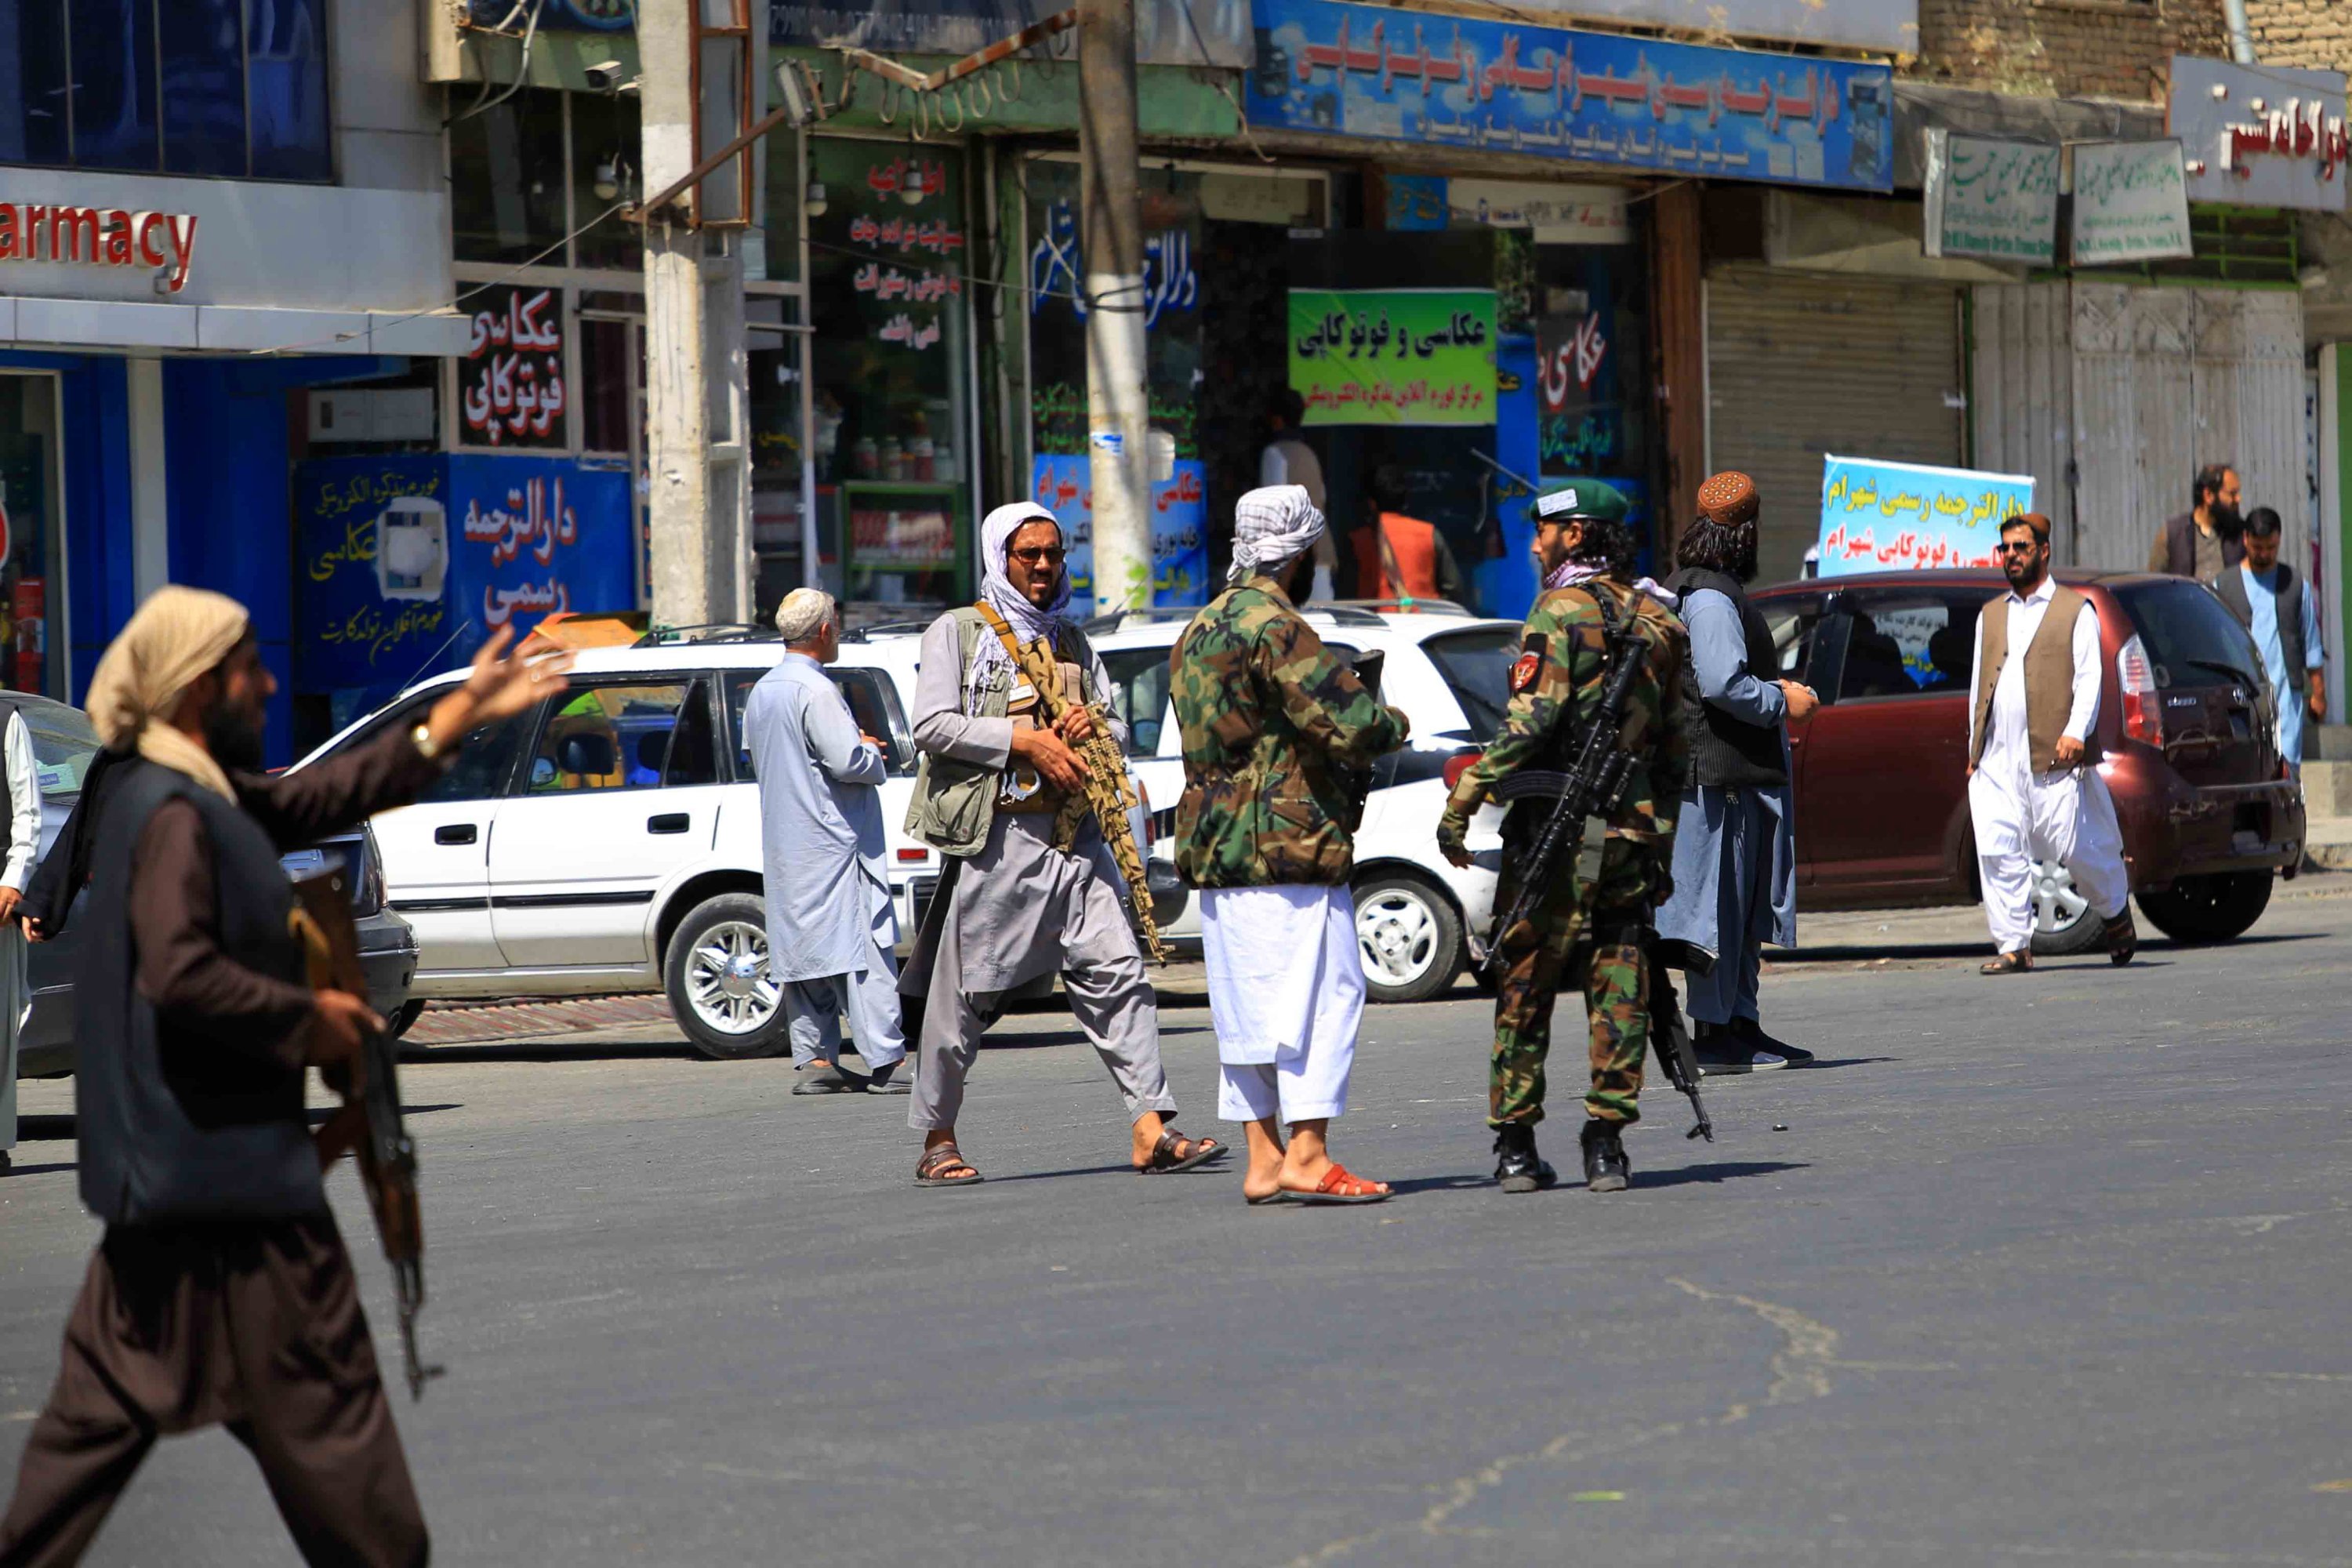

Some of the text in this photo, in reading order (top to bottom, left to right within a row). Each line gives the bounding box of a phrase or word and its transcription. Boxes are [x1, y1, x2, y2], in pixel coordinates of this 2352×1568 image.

[1479, 30, 1554, 102] عکاسی
[869, 158, 946, 201] اطاعیه
[0, 202, 198, 293] armacy
[1144, 230, 1198, 329] دارالتر
[469, 290, 562, 359] عکاسی
[1396, 326, 1408, 359] و
[1414, 311, 1486, 358] عکاسی
[1545, 311, 1607, 415] عکاسی
[465, 353, 568, 447] فوتوکاپی
[1827, 474, 1878, 512] شهرام
[1880, 491, 1931, 523] رسمی
[310, 518, 377, 581] عکاسی
[1826, 523, 1874, 560] شهرام
[483, 578, 571, 632] رسمی
